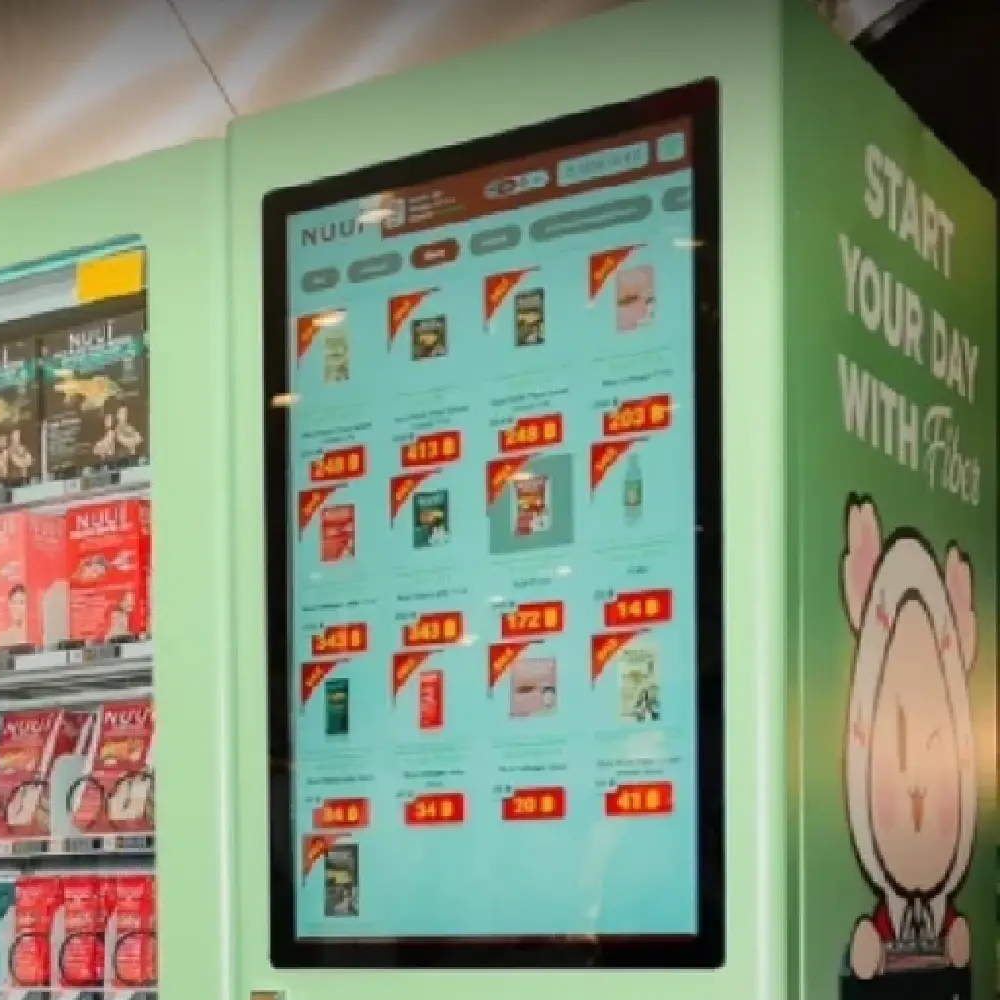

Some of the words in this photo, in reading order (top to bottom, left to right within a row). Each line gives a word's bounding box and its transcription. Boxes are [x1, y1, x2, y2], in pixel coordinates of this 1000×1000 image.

[864, 143, 956, 280] START
[838, 232, 923, 365] YOUR
[930, 308, 980, 404] DAY
[838, 353, 920, 471] WITH
